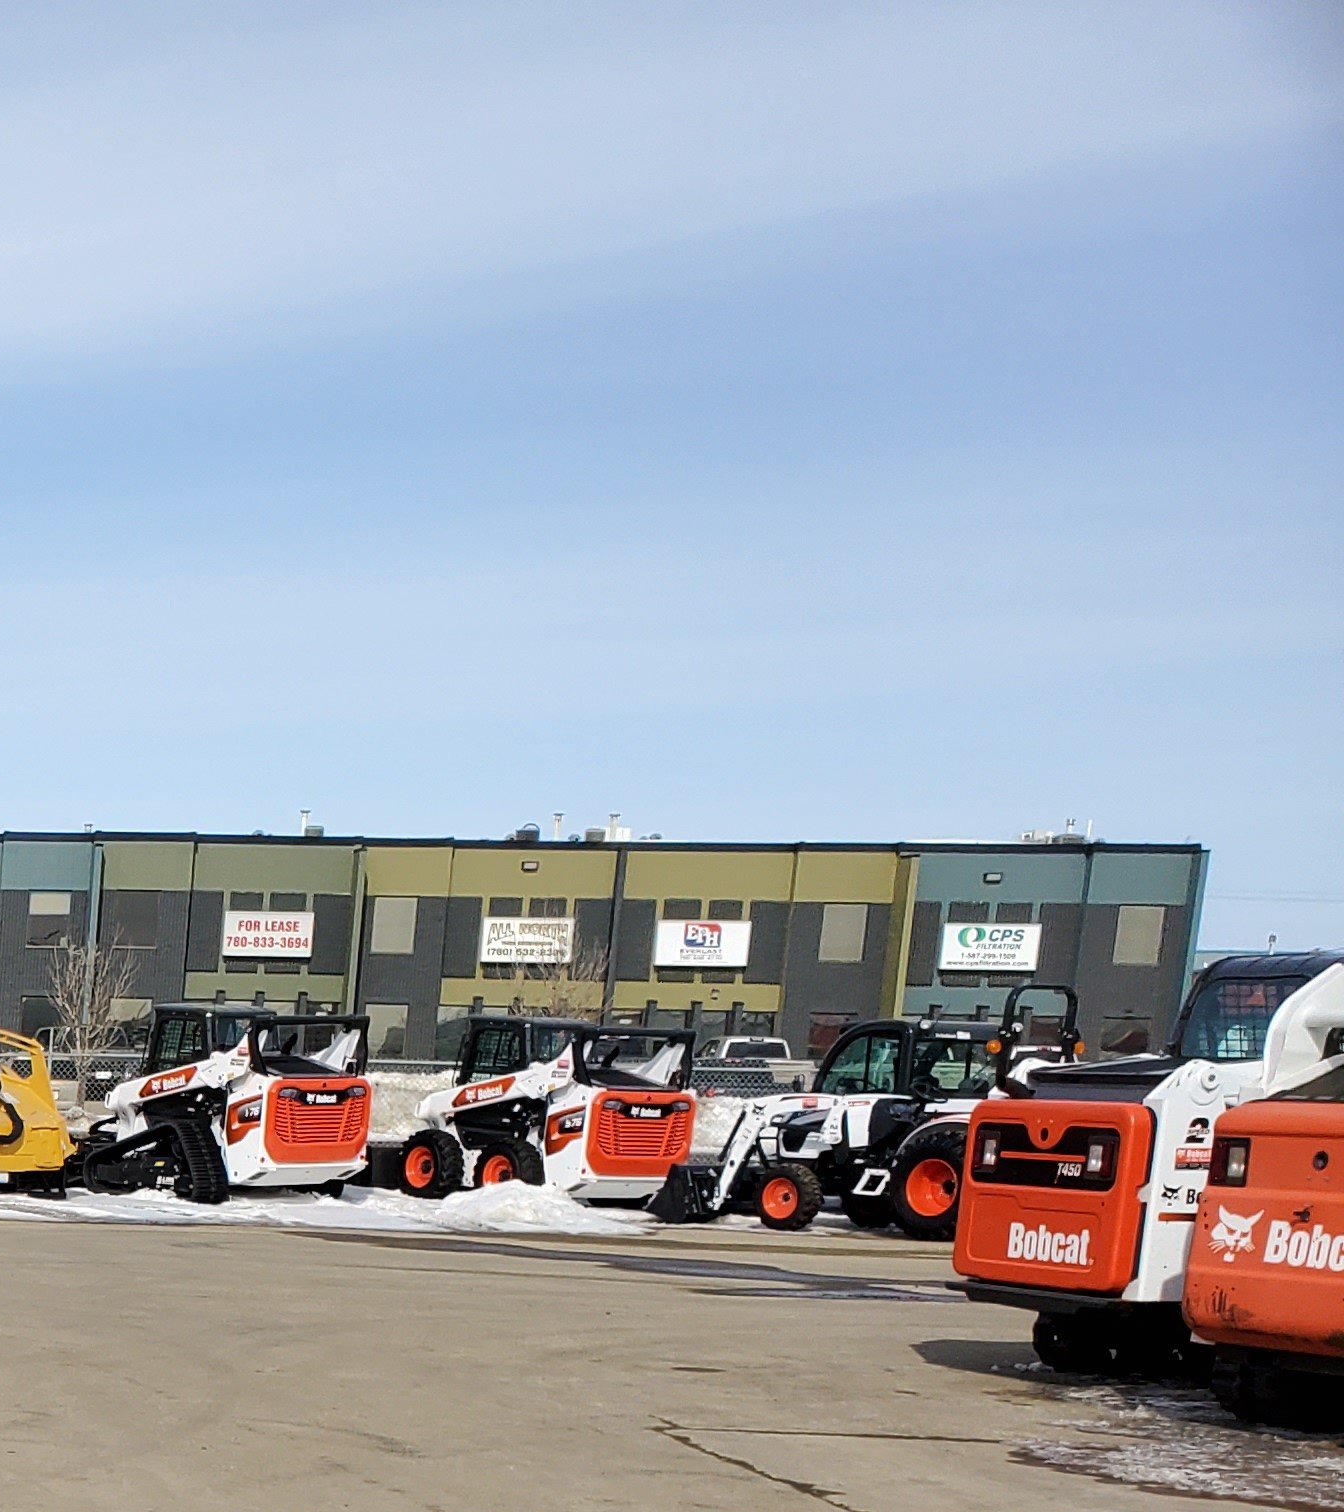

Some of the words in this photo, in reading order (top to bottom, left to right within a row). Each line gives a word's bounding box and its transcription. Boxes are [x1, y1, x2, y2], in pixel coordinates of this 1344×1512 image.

[238, 920, 261, 932] FOR
[265, 921, 300, 932] LEASE
[487, 922, 515, 945] ALL
[519, 923, 568, 946] NORTH
[989, 929, 1025, 942] CPS
[226, 936, 309, 948] 780-833-3694
[487, 948, 512, 956] (780)
[477, 1084, 503, 1100] Bobcat
[1055, 1163, 1082, 1177] T450
[1007, 1222, 1090, 1266] Bobcat
